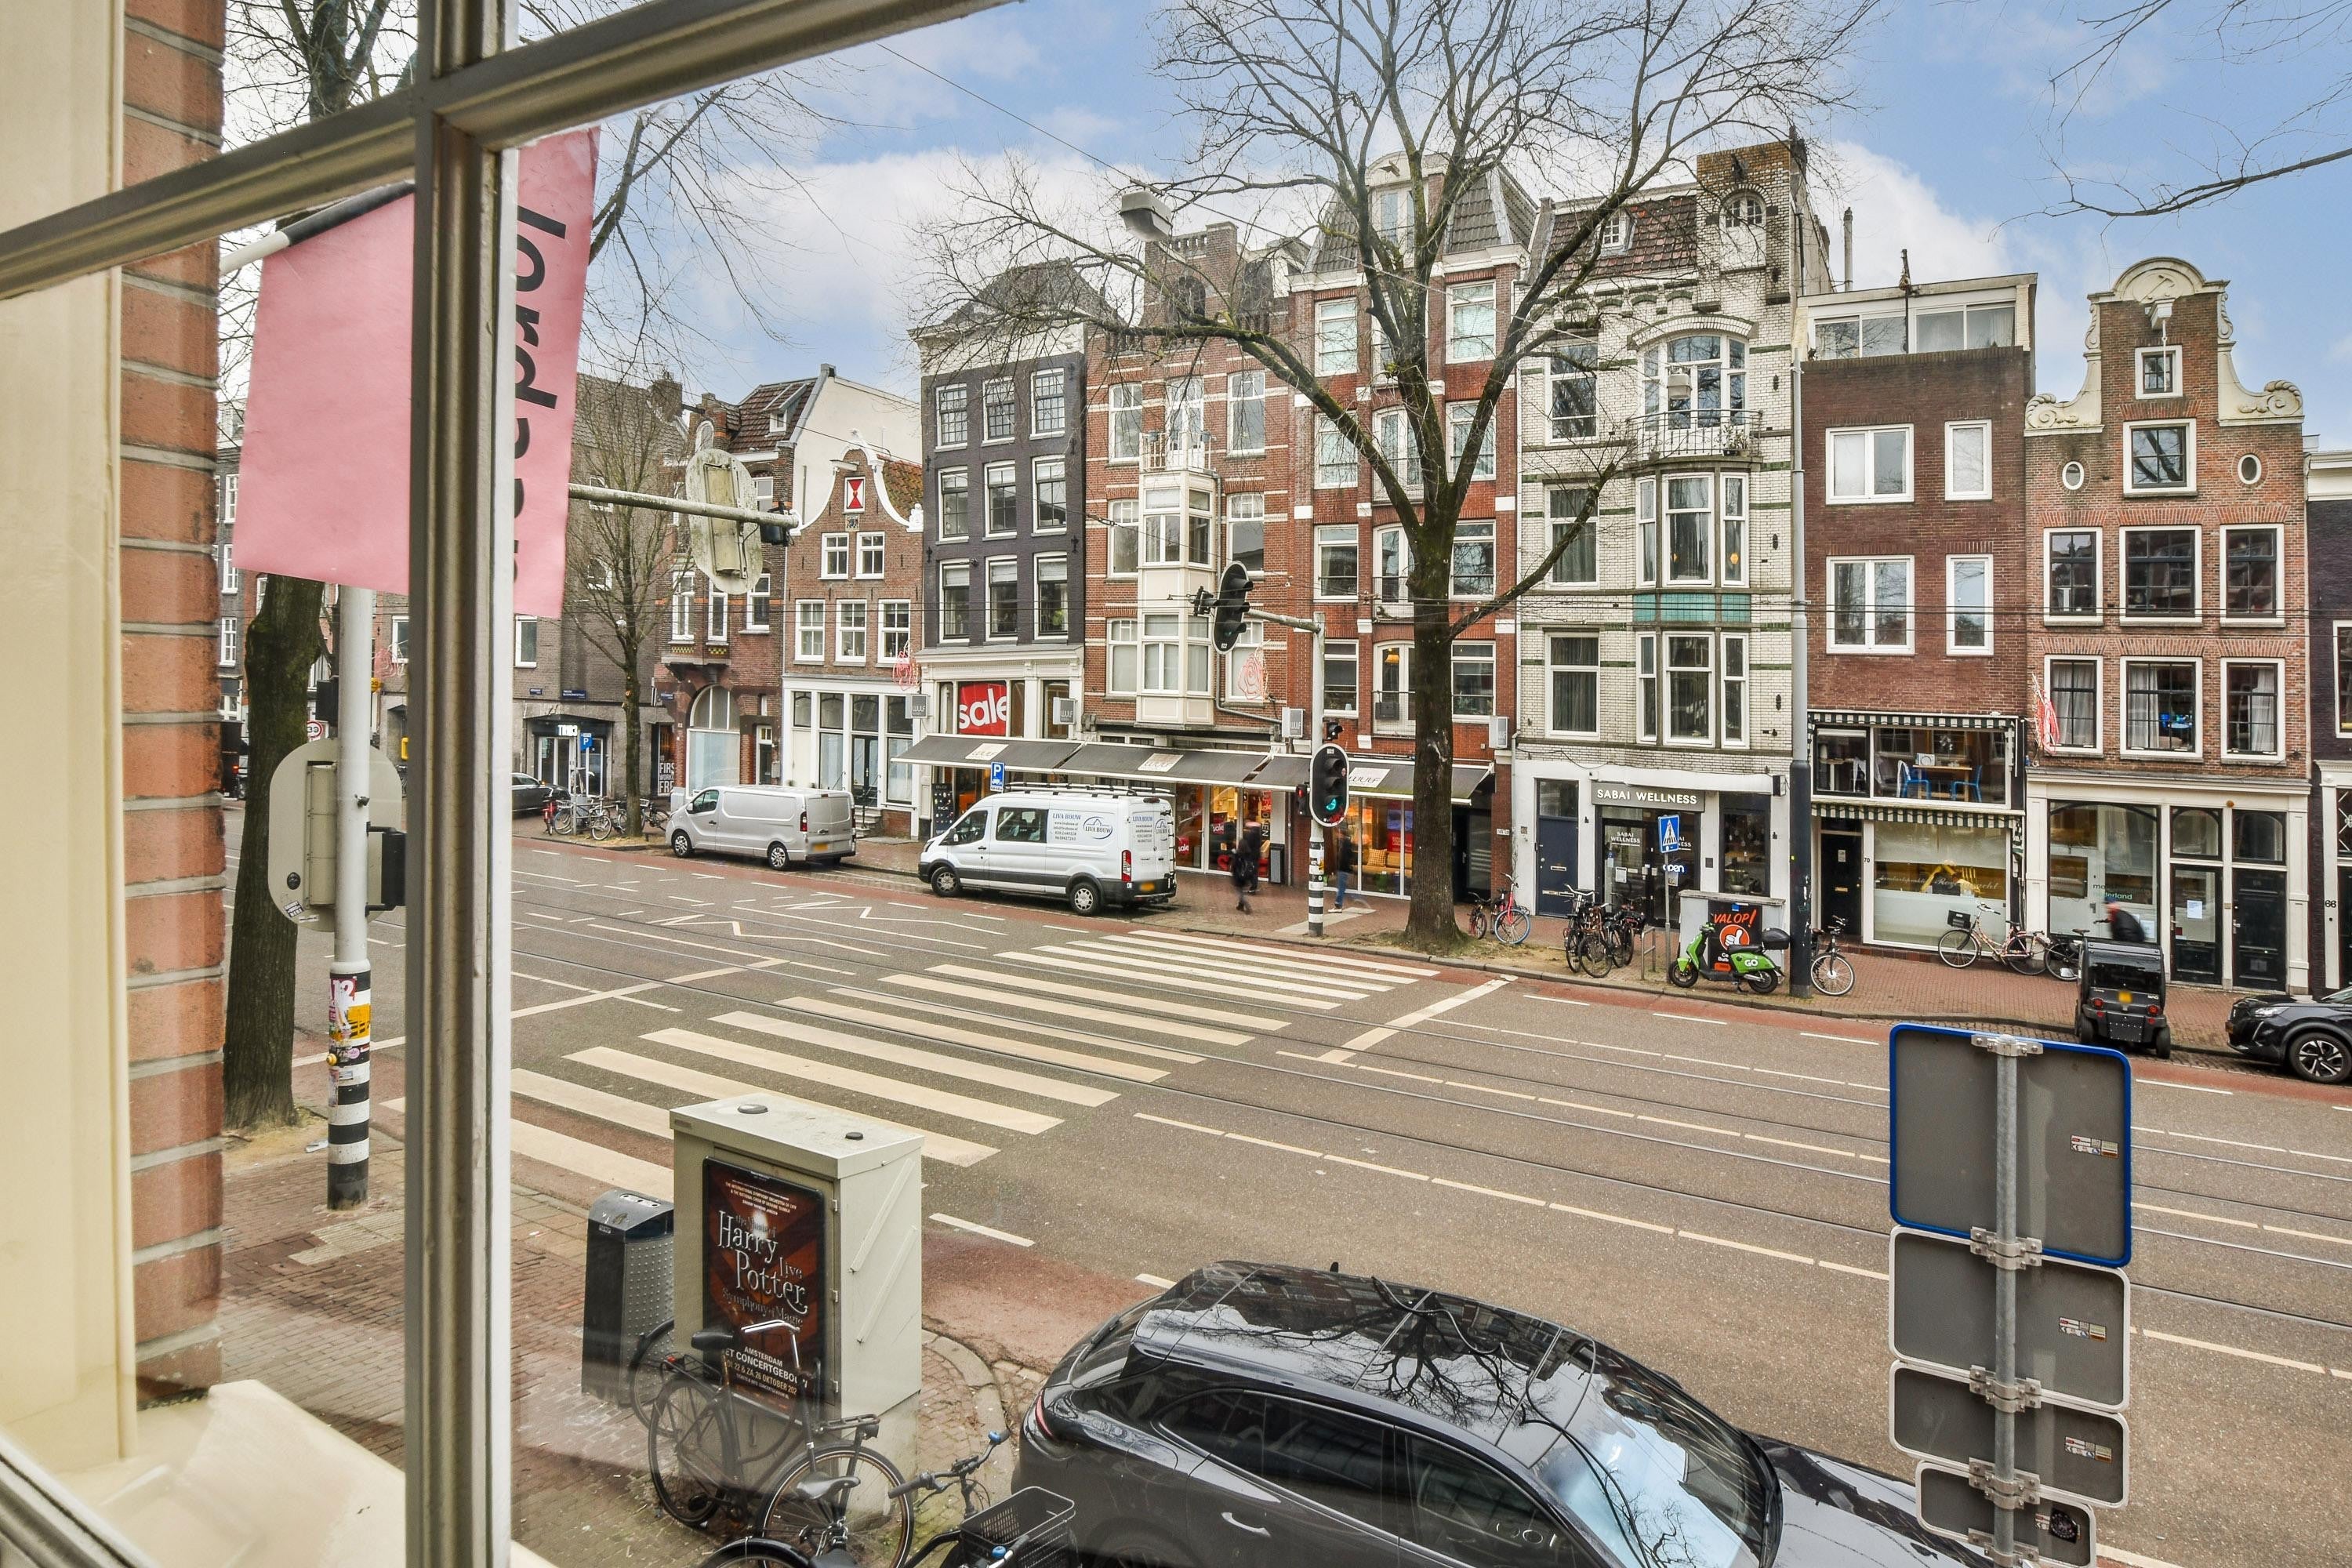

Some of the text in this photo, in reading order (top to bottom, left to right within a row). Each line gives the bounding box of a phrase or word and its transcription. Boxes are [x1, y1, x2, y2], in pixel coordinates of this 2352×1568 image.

[959, 688, 1007, 729] sale
[993, 764, 1001, 777] P
[1597, 789, 1697, 804] SABAI WELLNESS
[1178, 843, 1189, 851] sale
[718, 1210, 779, 1264] Harry
[779, 1257, 803, 1279] live
[735, 1250, 808, 1314] Potter
[745, 1346, 783, 1367] AMSTERDAM
[725, 1348, 808, 1388] ET CONCERTGEBO
[762, 1374, 787, 1391] OKTOBER
